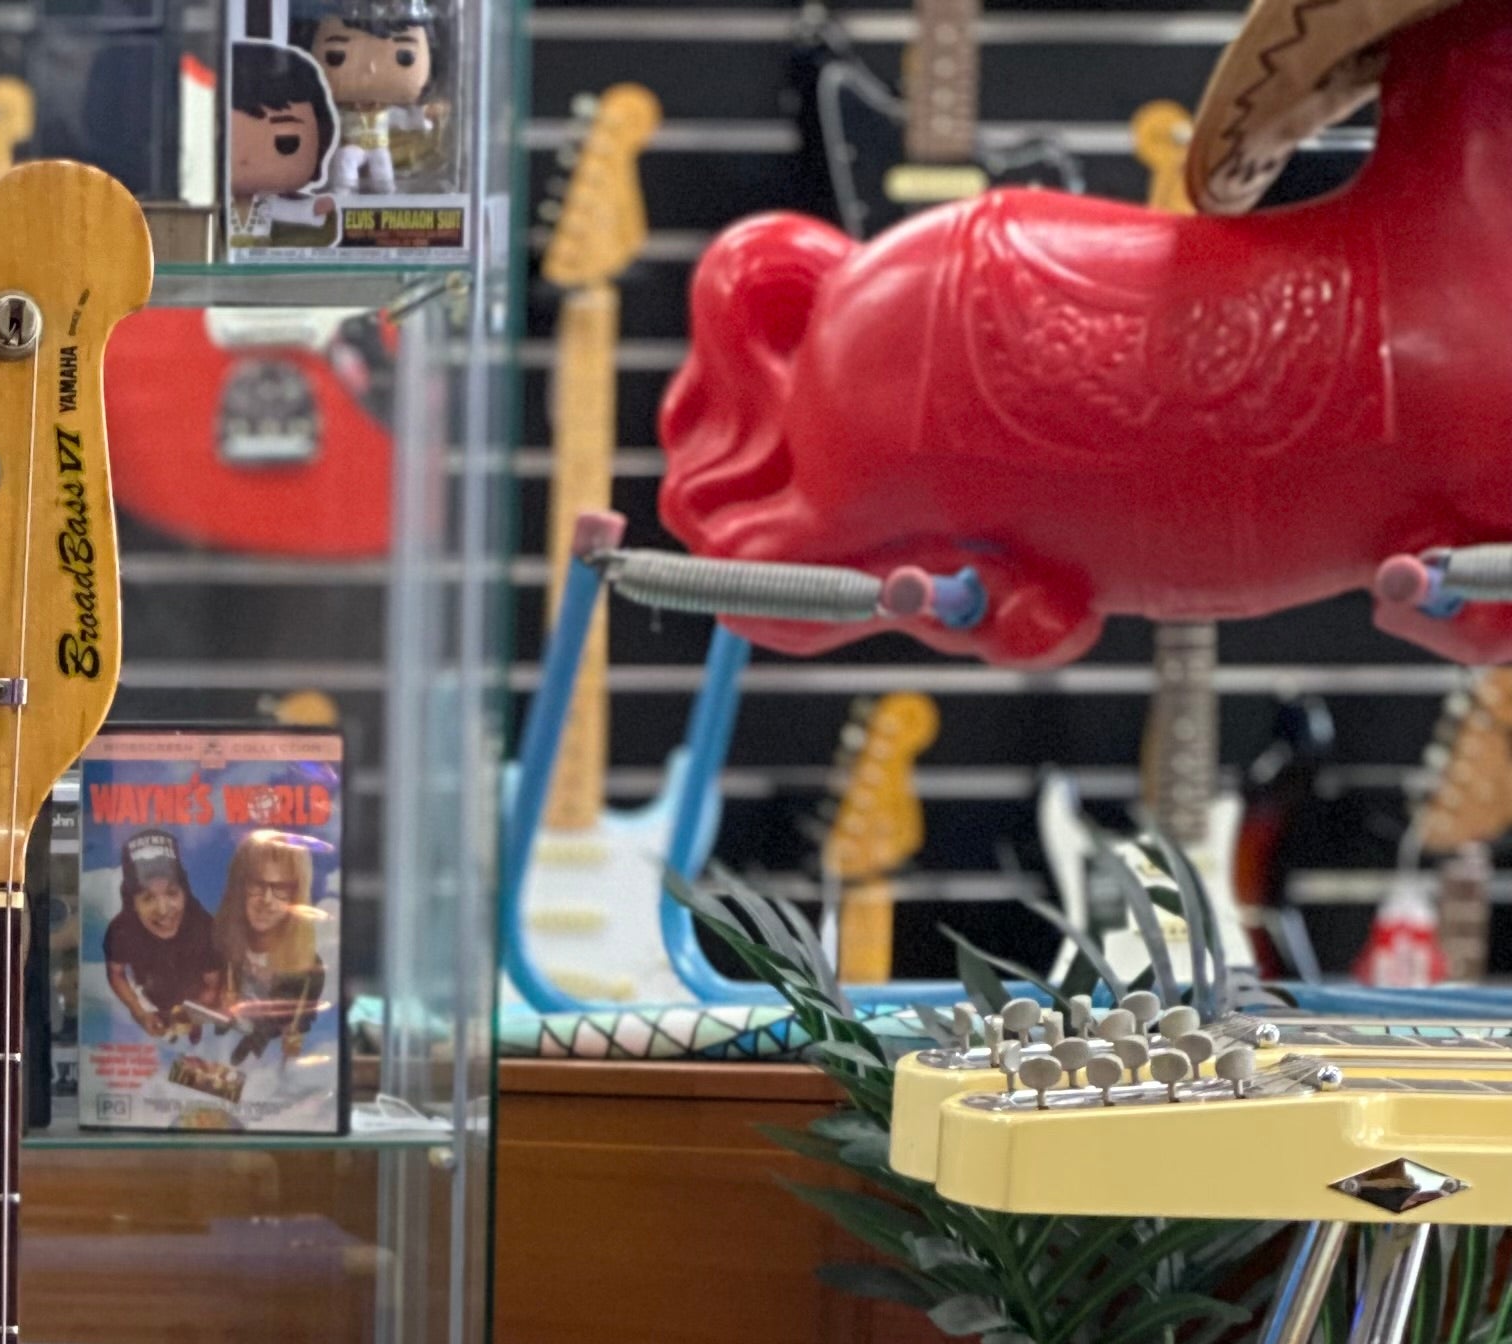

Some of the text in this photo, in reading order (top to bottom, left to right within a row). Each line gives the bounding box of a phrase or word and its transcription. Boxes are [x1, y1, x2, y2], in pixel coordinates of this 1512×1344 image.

[345, 209, 461, 229] ELVIS PHARAOH SUIT
[59, 346, 78, 413] YAMAHA
[56, 427, 100, 679] BroadBass VI
[89, 772, 332, 825] WAYNE'S WORLD
[102, 1099, 127, 1116] PG
